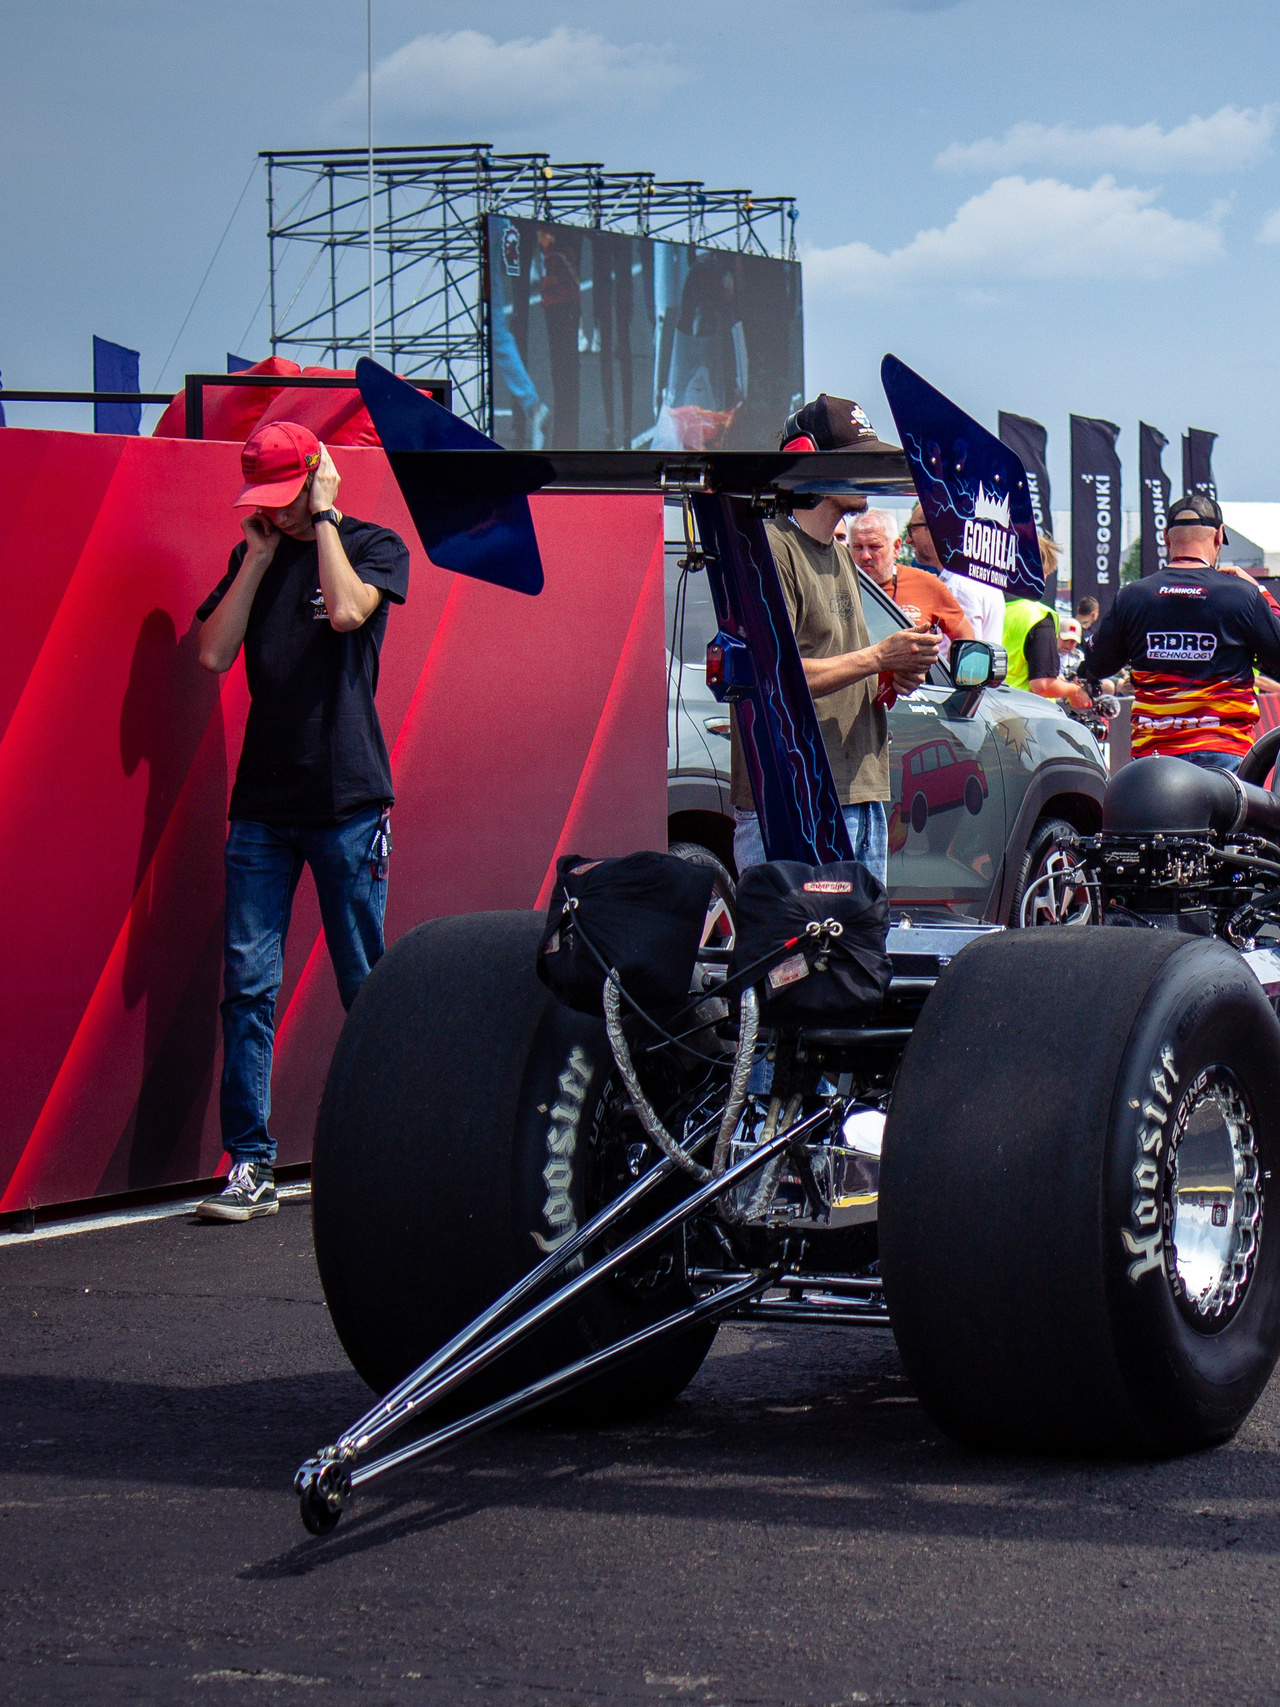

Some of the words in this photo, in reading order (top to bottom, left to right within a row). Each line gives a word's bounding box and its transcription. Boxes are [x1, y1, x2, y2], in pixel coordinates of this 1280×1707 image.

[963, 519, 1016, 572] GORILLA
[1096, 474, 1112, 585] ROSGONKI
[968, 563, 990, 583] ENERGY
[990, 569, 1008, 588] DRINK
[1149, 650, 1213, 660] TECHNOLOGY
